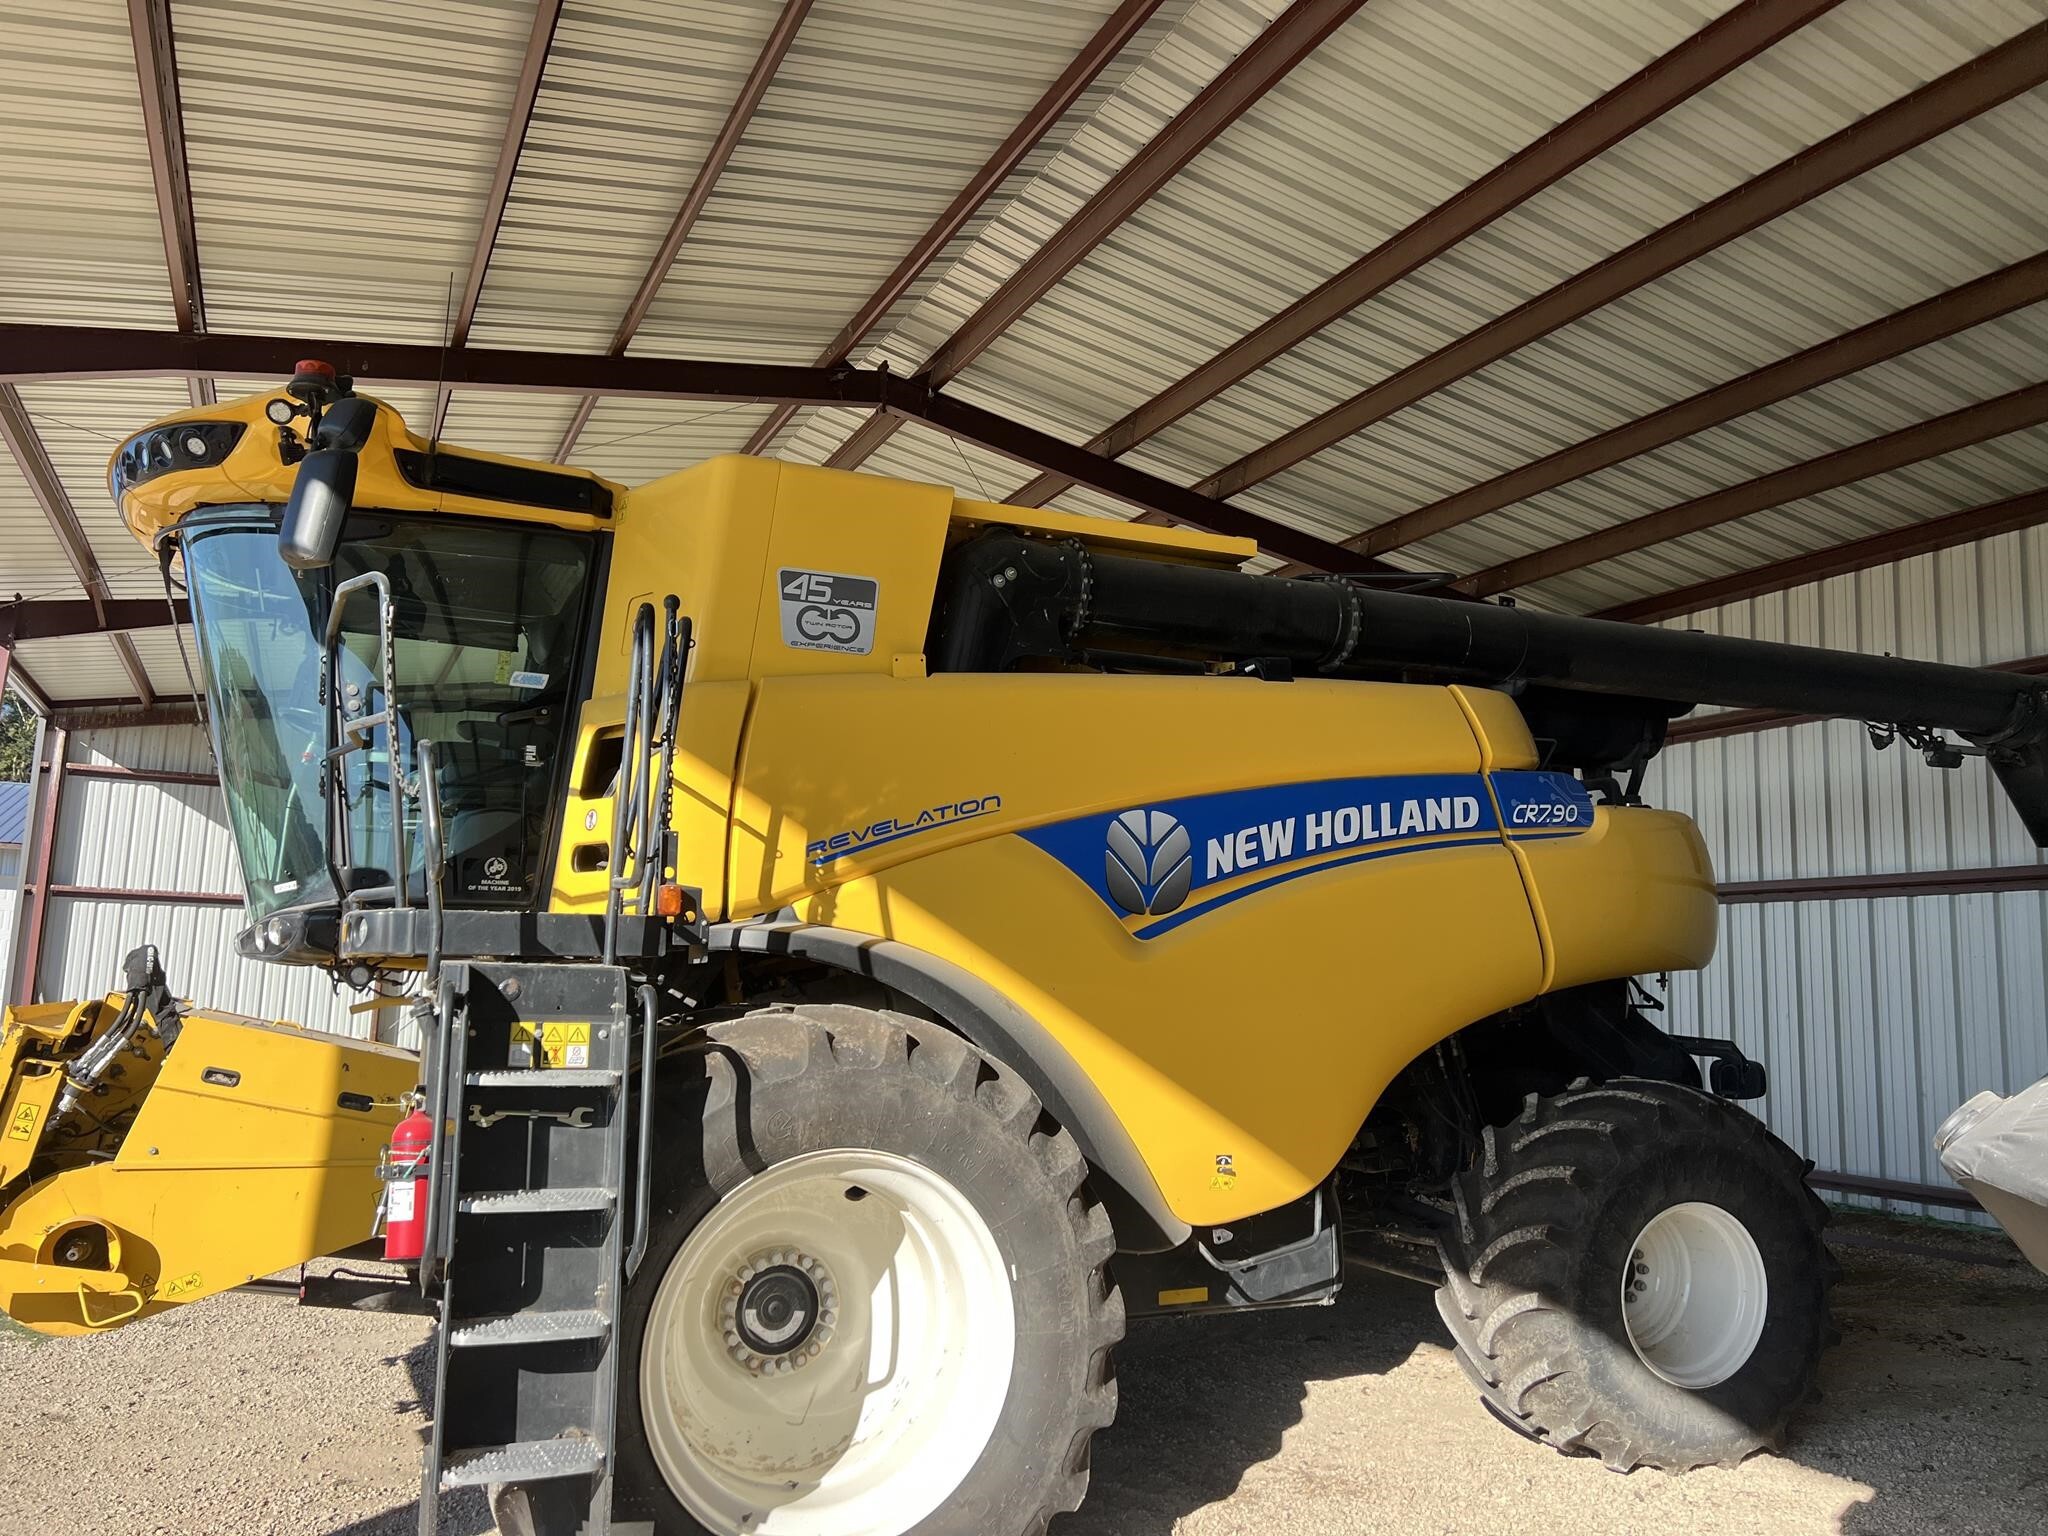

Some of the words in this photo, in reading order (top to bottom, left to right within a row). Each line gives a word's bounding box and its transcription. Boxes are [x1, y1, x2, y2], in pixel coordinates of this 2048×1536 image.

[783, 573, 834, 603] 45
[832, 598, 873, 609] YEARS
[825, 622, 852, 630] ROTOR
[790, 640, 865, 653] EXPERIENCE
[1512, 804, 1578, 824] CR7.90
[806, 795, 1001, 858] REVELATION
[1206, 816, 1296, 880] NEW
[1305, 796, 1480, 851] HOLLAND
